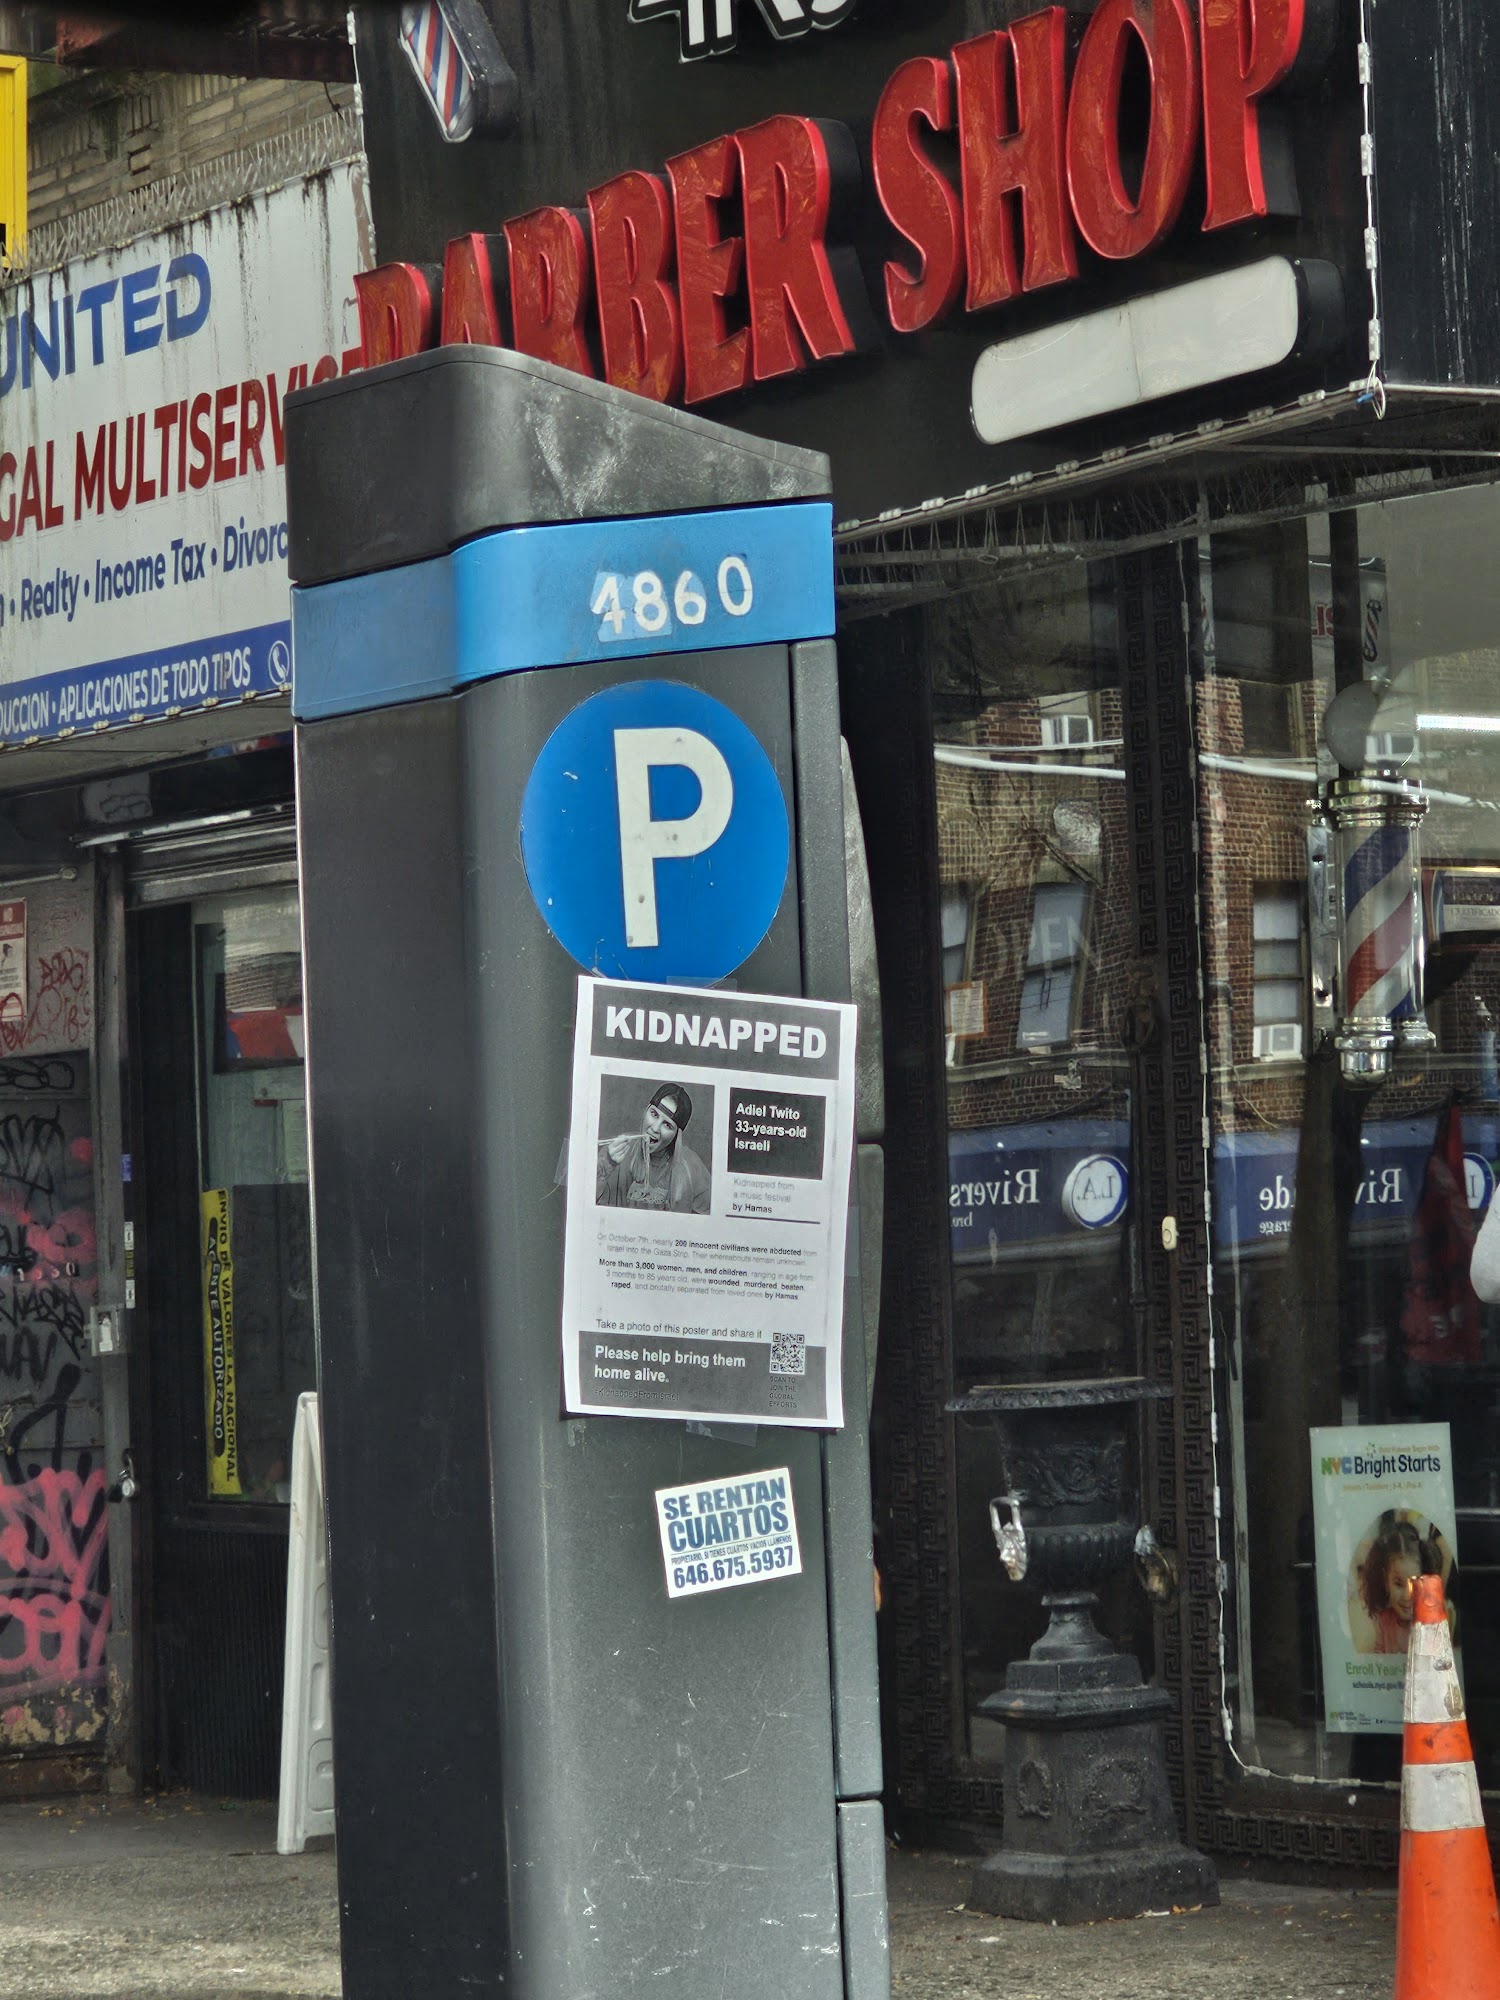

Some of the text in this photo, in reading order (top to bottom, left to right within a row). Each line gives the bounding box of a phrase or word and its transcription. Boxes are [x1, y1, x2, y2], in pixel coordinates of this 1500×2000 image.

[872, 0, 1304, 332] SHOP
[0, 346, 362, 542] GAL MULTISERV
[21, 568, 79, 622] Realty
[95, 553, 166, 604] Income
[171, 538, 207, 585] Tax
[223, 516, 288, 573] Divorc
[592, 556, 754, 635] 4860
[58, 670, 148, 724] APLICACIONES
[152, 667, 169, 705] DE
[171, 656, 209, 700] TODO
[211, 646, 251, 692] TIPOS
[614, 727, 734, 948] P
[605, 1005, 827, 1059] KIDNAPPED
[735, 1102, 800, 1120] Adiel Twito
[735, 1119, 807, 1138] 33-years-old
[734, 1137, 770, 1151] Israeli
[734, 1178, 795, 1191] Kidnapped from
[733, 1191, 792, 1203] a music festival
[217, 1190, 228, 1244] ENVIO
[732, 1203, 773, 1213] by Hamas
[607, 1244, 625, 1253] Israel
[626, 1246, 639, 1254] into
[640, 1246, 652, 1255] the
[653, 1247, 671, 1257] Gaza
[692, 1250, 709, 1259] Their
[709, 1254, 751, 1262] whereabouts
[753, 1257, 775, 1265] remain
[609, 1233, 636, 1243] October
[653, 1238, 674, 1248] nearly
[675, 1239, 688, 1248] 200
[689, 1240, 719, 1250] innocent
[720, 1243, 750, 1252] civilians
[769, 1246, 802, 1256] abducted
[803, 1249, 818, 1257] from
[219, 1250, 231, 1271] DE
[599, 1258, 617, 1267] More
[618, 1260, 634, 1268] than
[635, 1261, 656, 1270] 3,000
[656, 1263, 684, 1272] women,
[704, 1267, 718, 1275] and
[751, 1271, 777, 1280] ranging
[778, 1272, 784, 1280] in
[785, 1273, 798, 1282] age
[799, 1273, 814, 1281] from
[606, 1269, 611, 1277] 3
[612, 1270, 637, 1280] months
[638, 1272, 645, 1280] to
[657, 1275, 676, 1283] years
[635, 1282, 648, 1291] and
[649, 1283, 675, 1293] brutally
[677, 1286, 709, 1295] separated
[710, 1288, 726, 1296] from
[727, 1289, 746, 1297] loved
[764, 1291, 774, 1301] by
[596, 1319, 763, 1339] Take a photo of this poster and share it
[595, 1344, 746, 1369] Please help bring them
[213, 1318, 224, 1439] AUTORIZADO
[226, 1365, 233, 1386] LA
[594, 1364, 669, 1383] home alive.
[788, 1376, 797, 1384] TO
[595, 1387, 681, 1401] KdnappedFromsrael
[784, 1385, 797, 1393] THE
[225, 1392, 236, 1482] NACIONAL
[1321, 1454, 1441, 1478] NYC Bright Starts
[663, 1477, 786, 1520] SE RENTAN
[667, 1501, 789, 1552] CUARTOS
[704, 1552, 709, 1560] SI
[709, 1549, 727, 1559] TIENES
[726, 1543, 749, 1555] CUARTOS
[673, 1545, 793, 1588] 646.675.5937
[1345, 1662, 1374, 1676] Enroll
